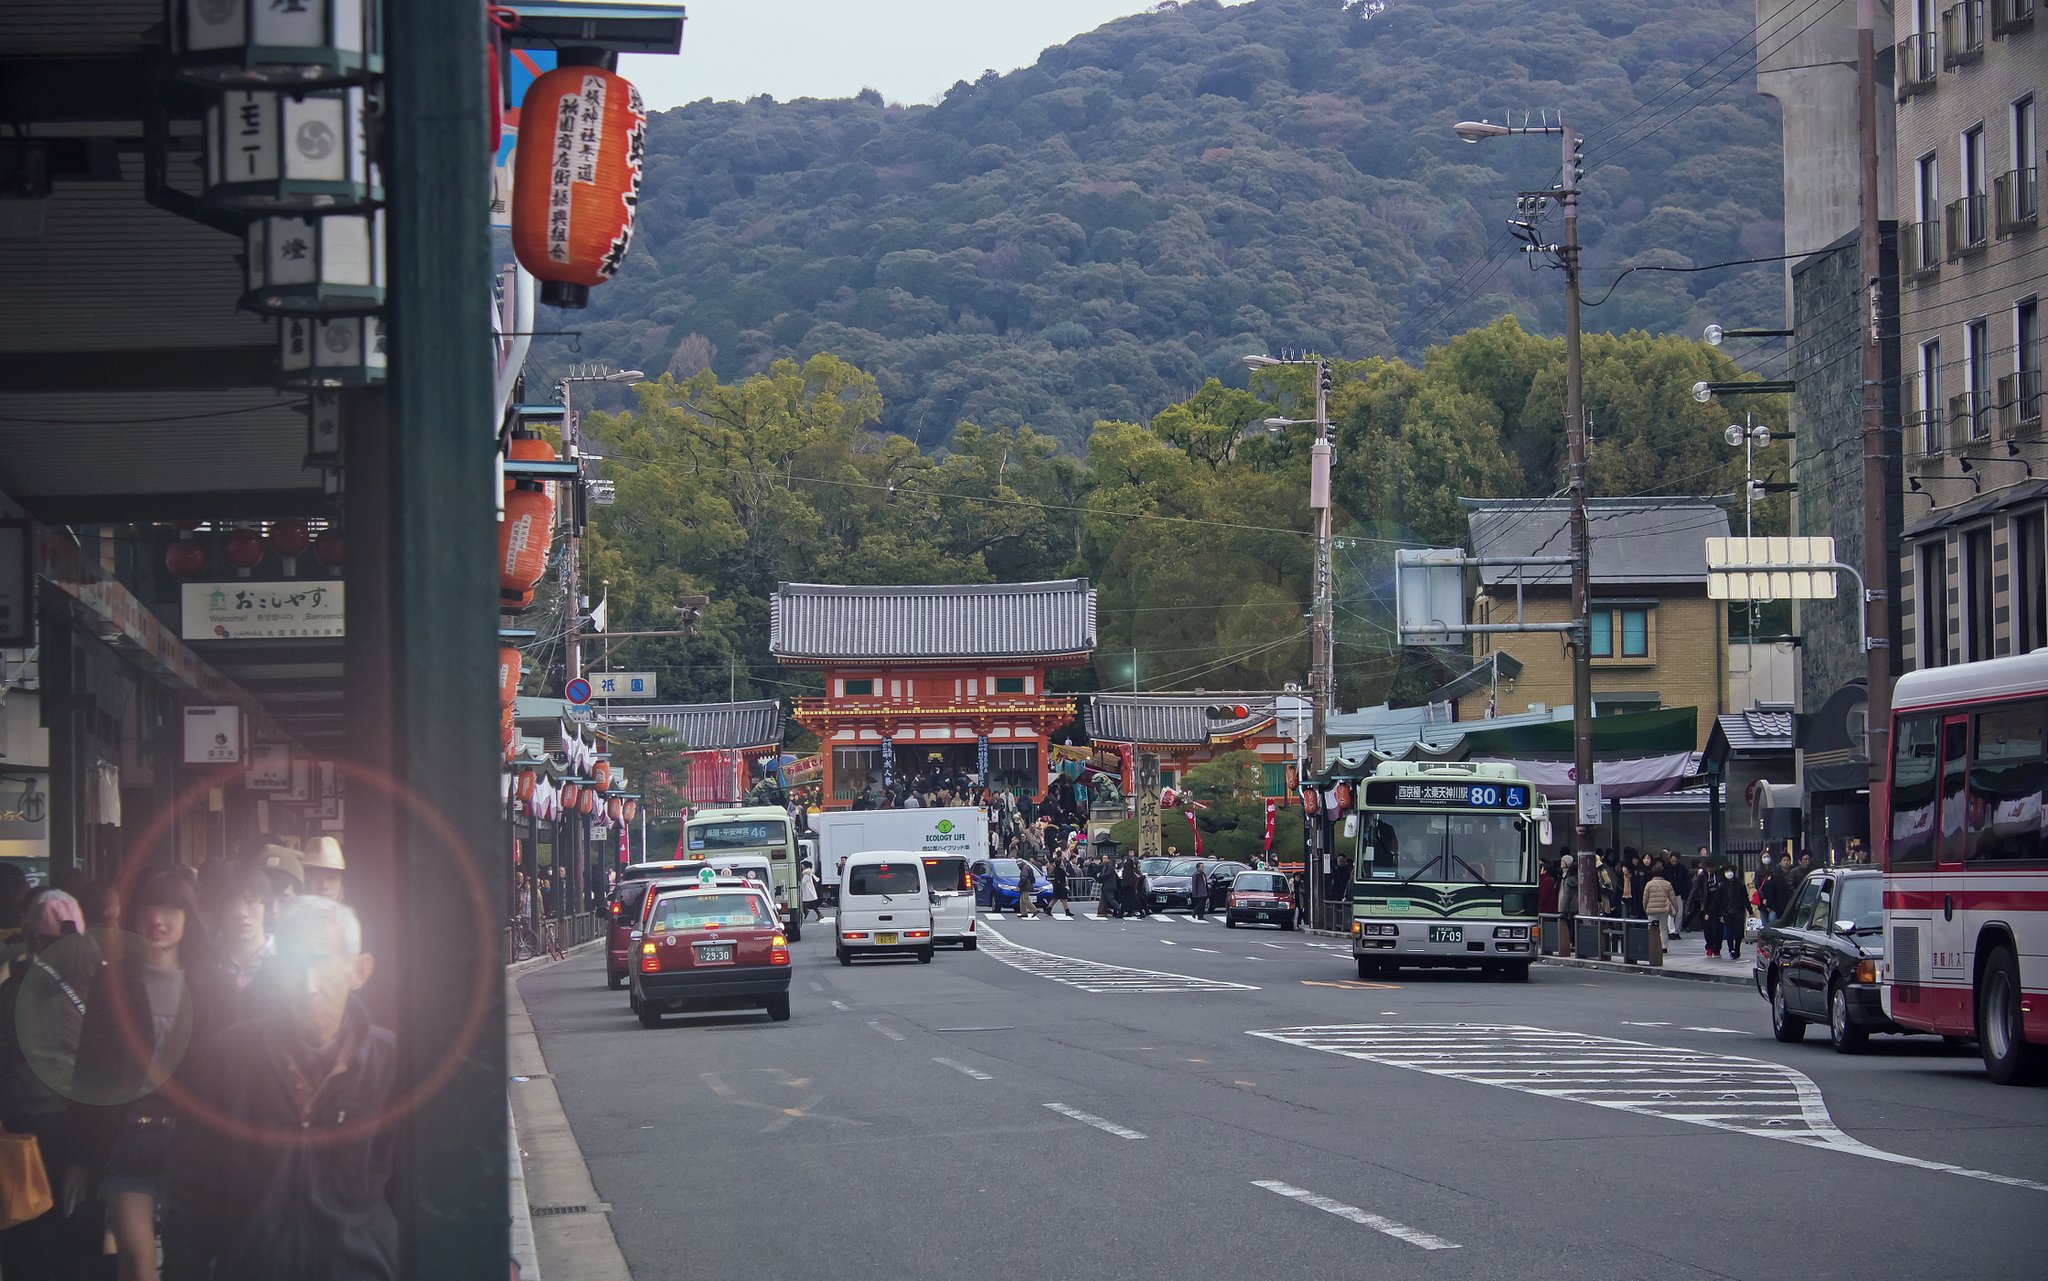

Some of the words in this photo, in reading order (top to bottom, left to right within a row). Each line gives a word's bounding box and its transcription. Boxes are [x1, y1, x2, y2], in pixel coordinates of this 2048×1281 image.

[548, 97, 579, 260] 祇園商店街振興組合
[602, 678, 644, 692] 祇園
[1398, 785, 1468, 799] 西京極・太秦天神川駅
[1470, 787, 1496, 805] 80
[750, 826, 767, 838] 46
[926, 834, 953, 842] ECOLOGY
[954, 833, 966, 841] LIFE
[705, 951, 729, 961] 29-30
